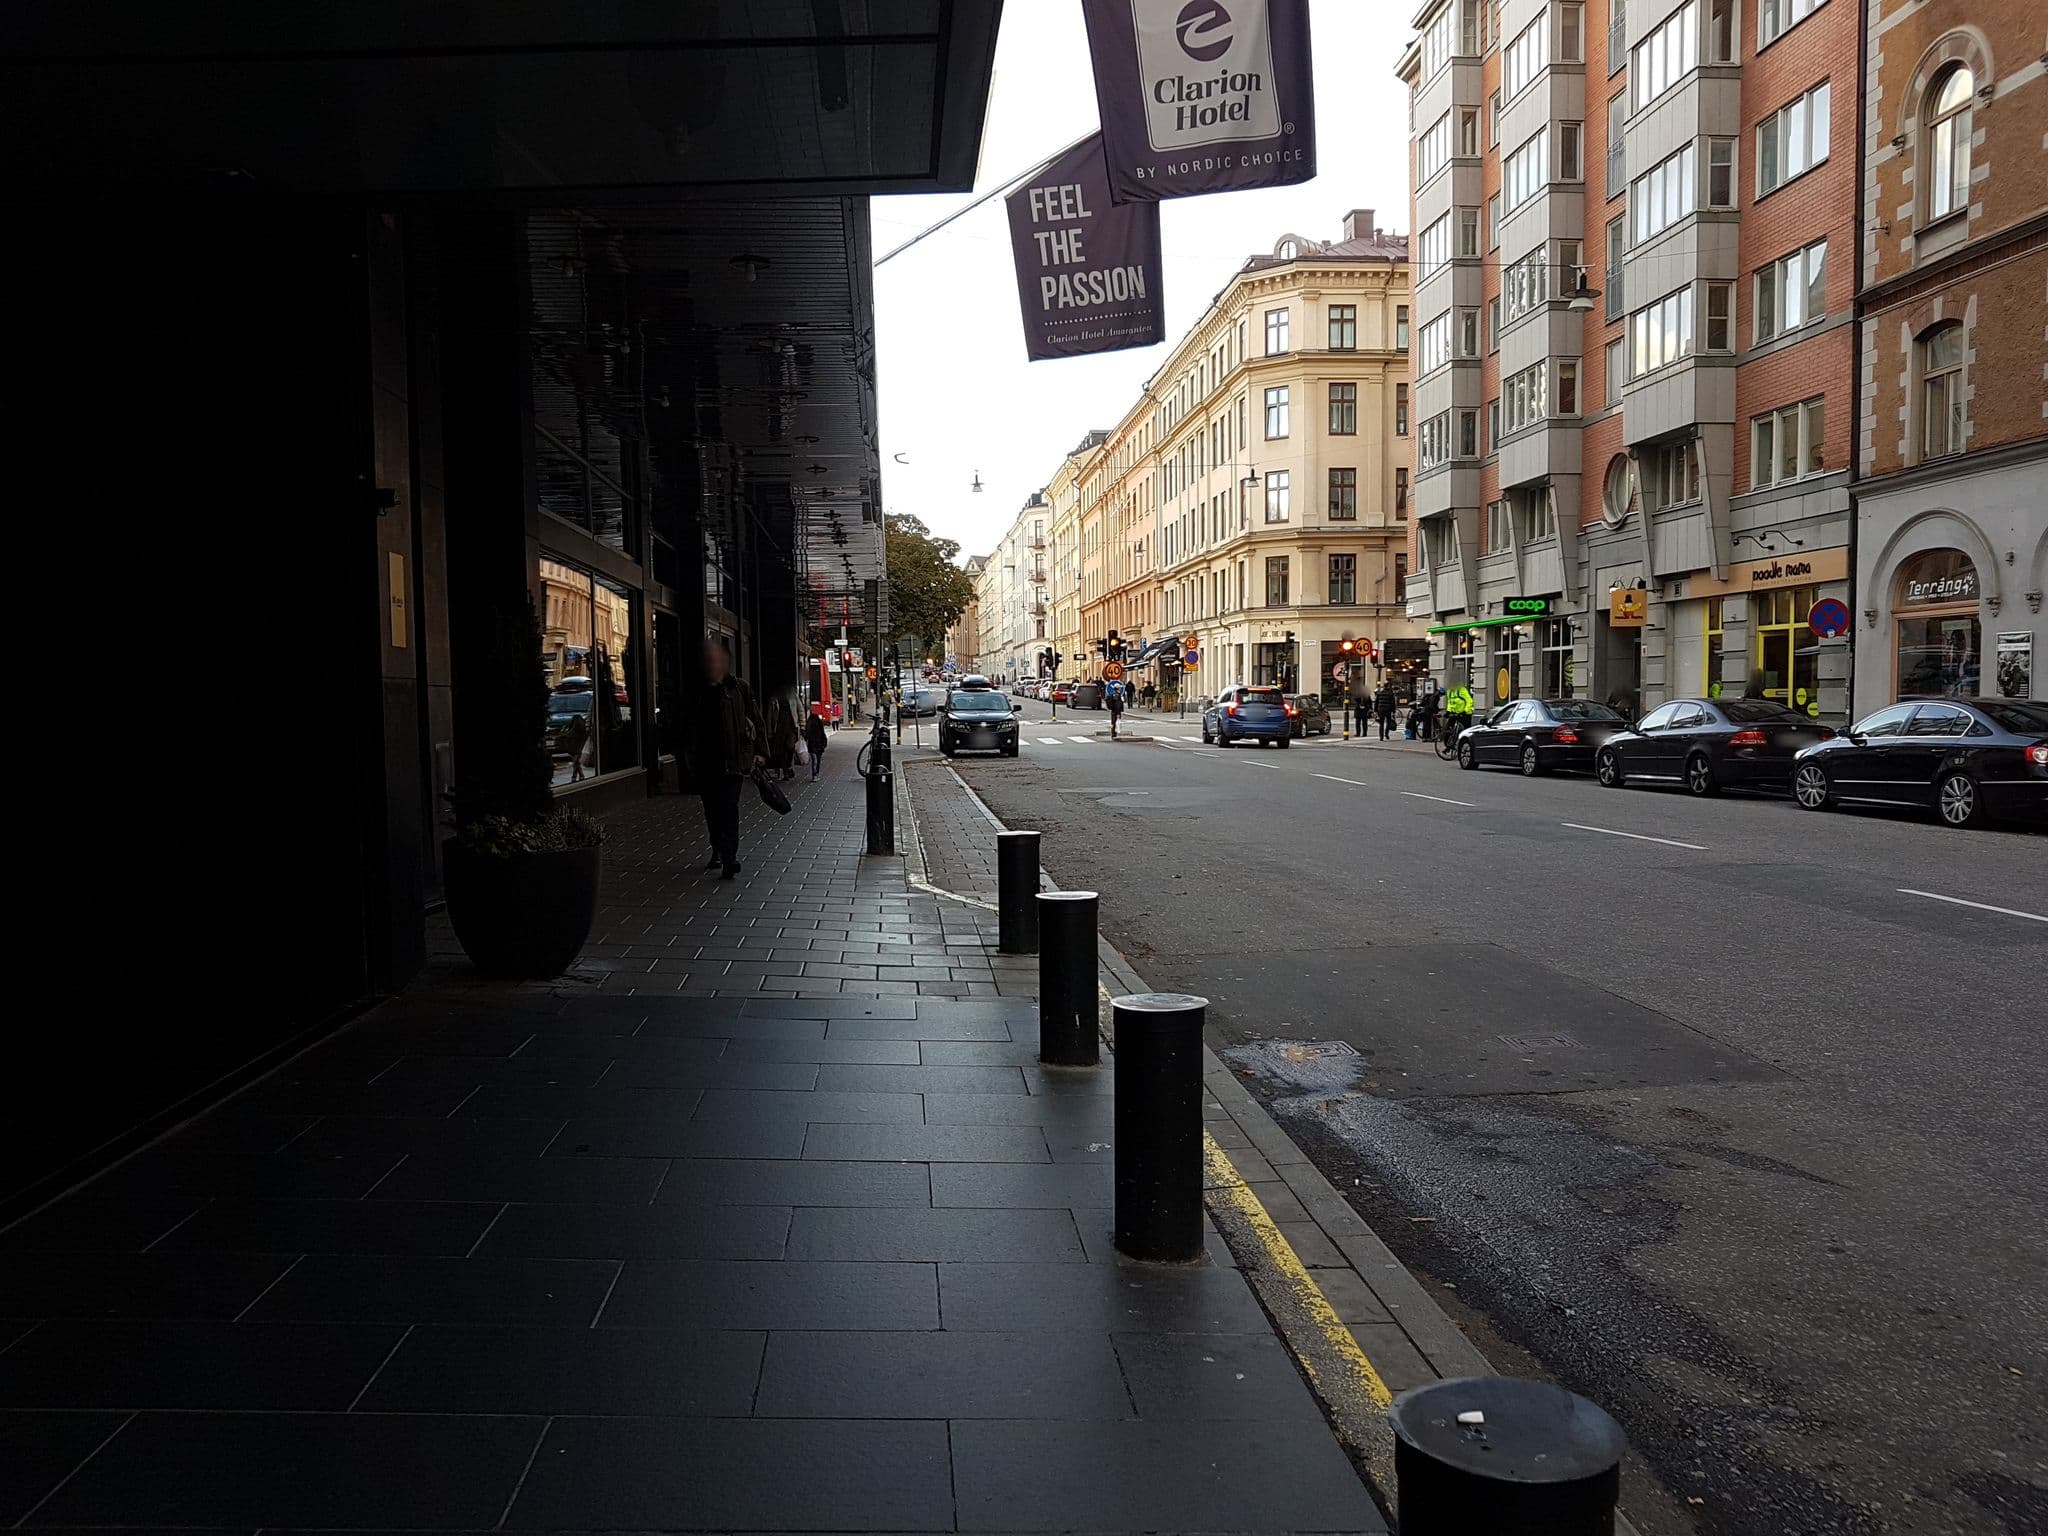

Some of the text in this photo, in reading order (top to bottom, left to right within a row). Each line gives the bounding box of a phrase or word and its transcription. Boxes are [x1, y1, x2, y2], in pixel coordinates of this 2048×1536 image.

[1153, 68, 1262, 104] Clarion
[1175, 94, 1250, 132] Hotel
[1136, 148, 1303, 179] BY NORDIC CHOICE
[1029, 183, 1092, 223] FEEL
[1033, 228, 1086, 266] THE
[1040, 264, 1146, 311] PASSION
[1046, 335, 1079, 345] Clarion
[1081, 328, 1105, 341] Hotel
[1508, 600, 1546, 612] coop
[1356, 642, 1370, 652] 40
[1108, 665, 1120, 677] 40
